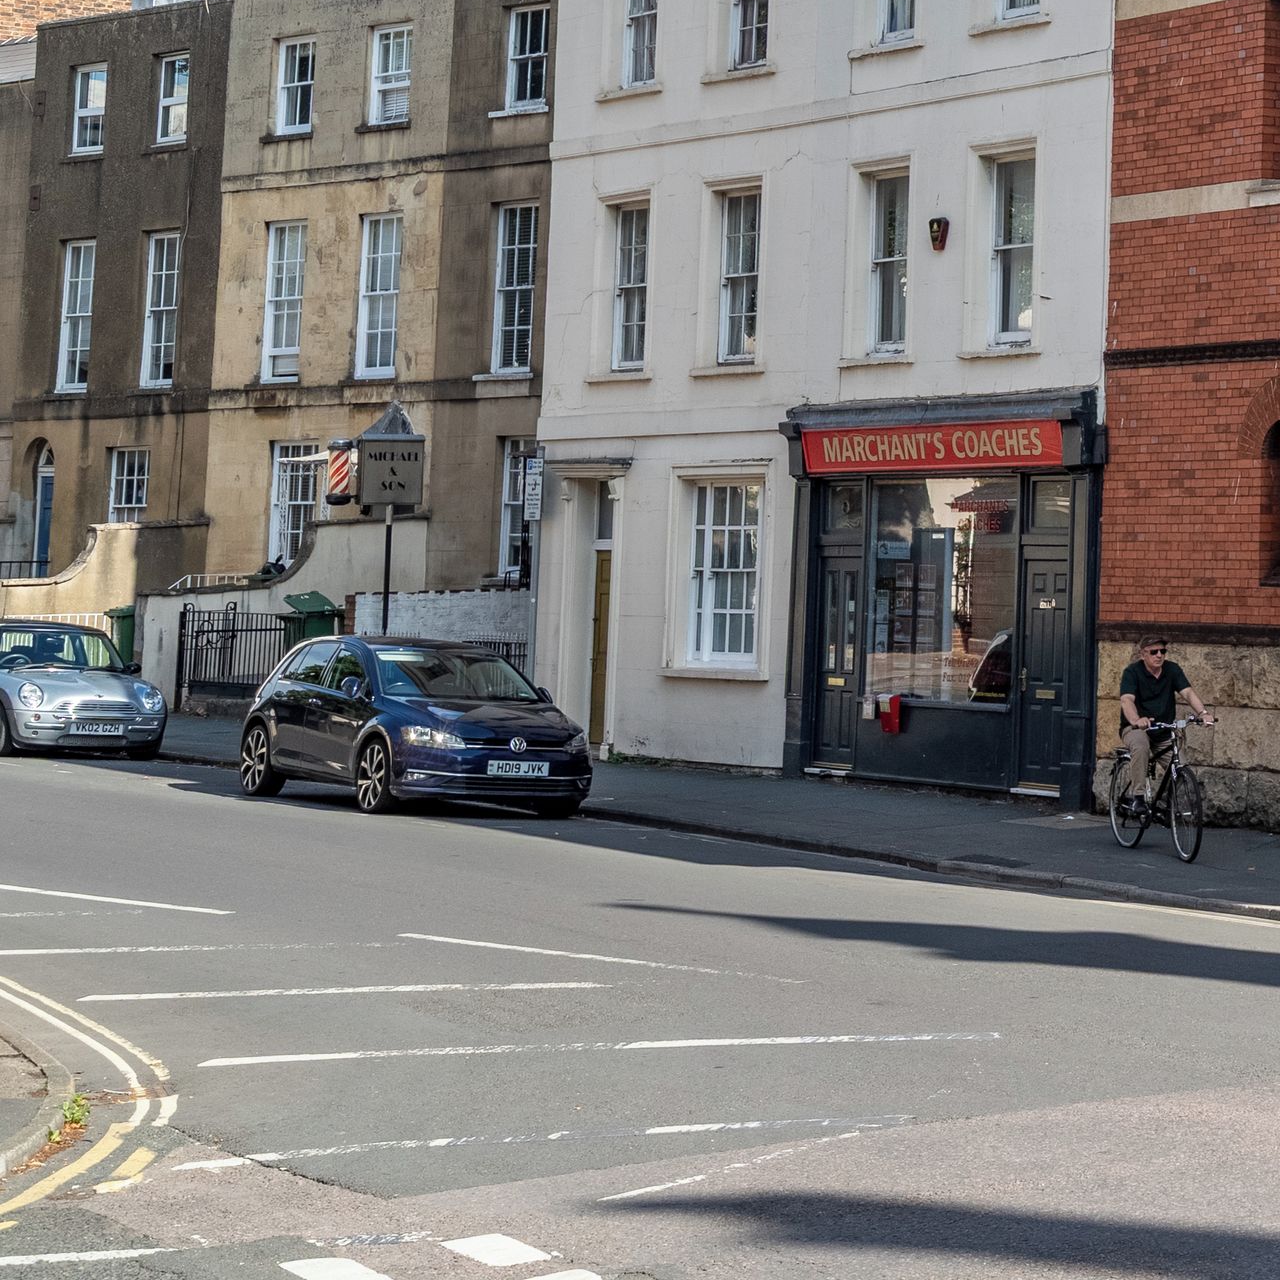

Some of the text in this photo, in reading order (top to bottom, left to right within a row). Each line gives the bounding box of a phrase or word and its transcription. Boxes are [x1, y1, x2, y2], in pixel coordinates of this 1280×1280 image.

[822, 426, 1043, 463] MARCHANT'S COACHES
[368, 451, 419, 462] MICHAEL
[389, 466, 398, 477] &
[381, 481, 406, 491] SON
[75, 723, 120, 733] VK02 GZH
[496, 763, 545, 774] HD19 JVK
